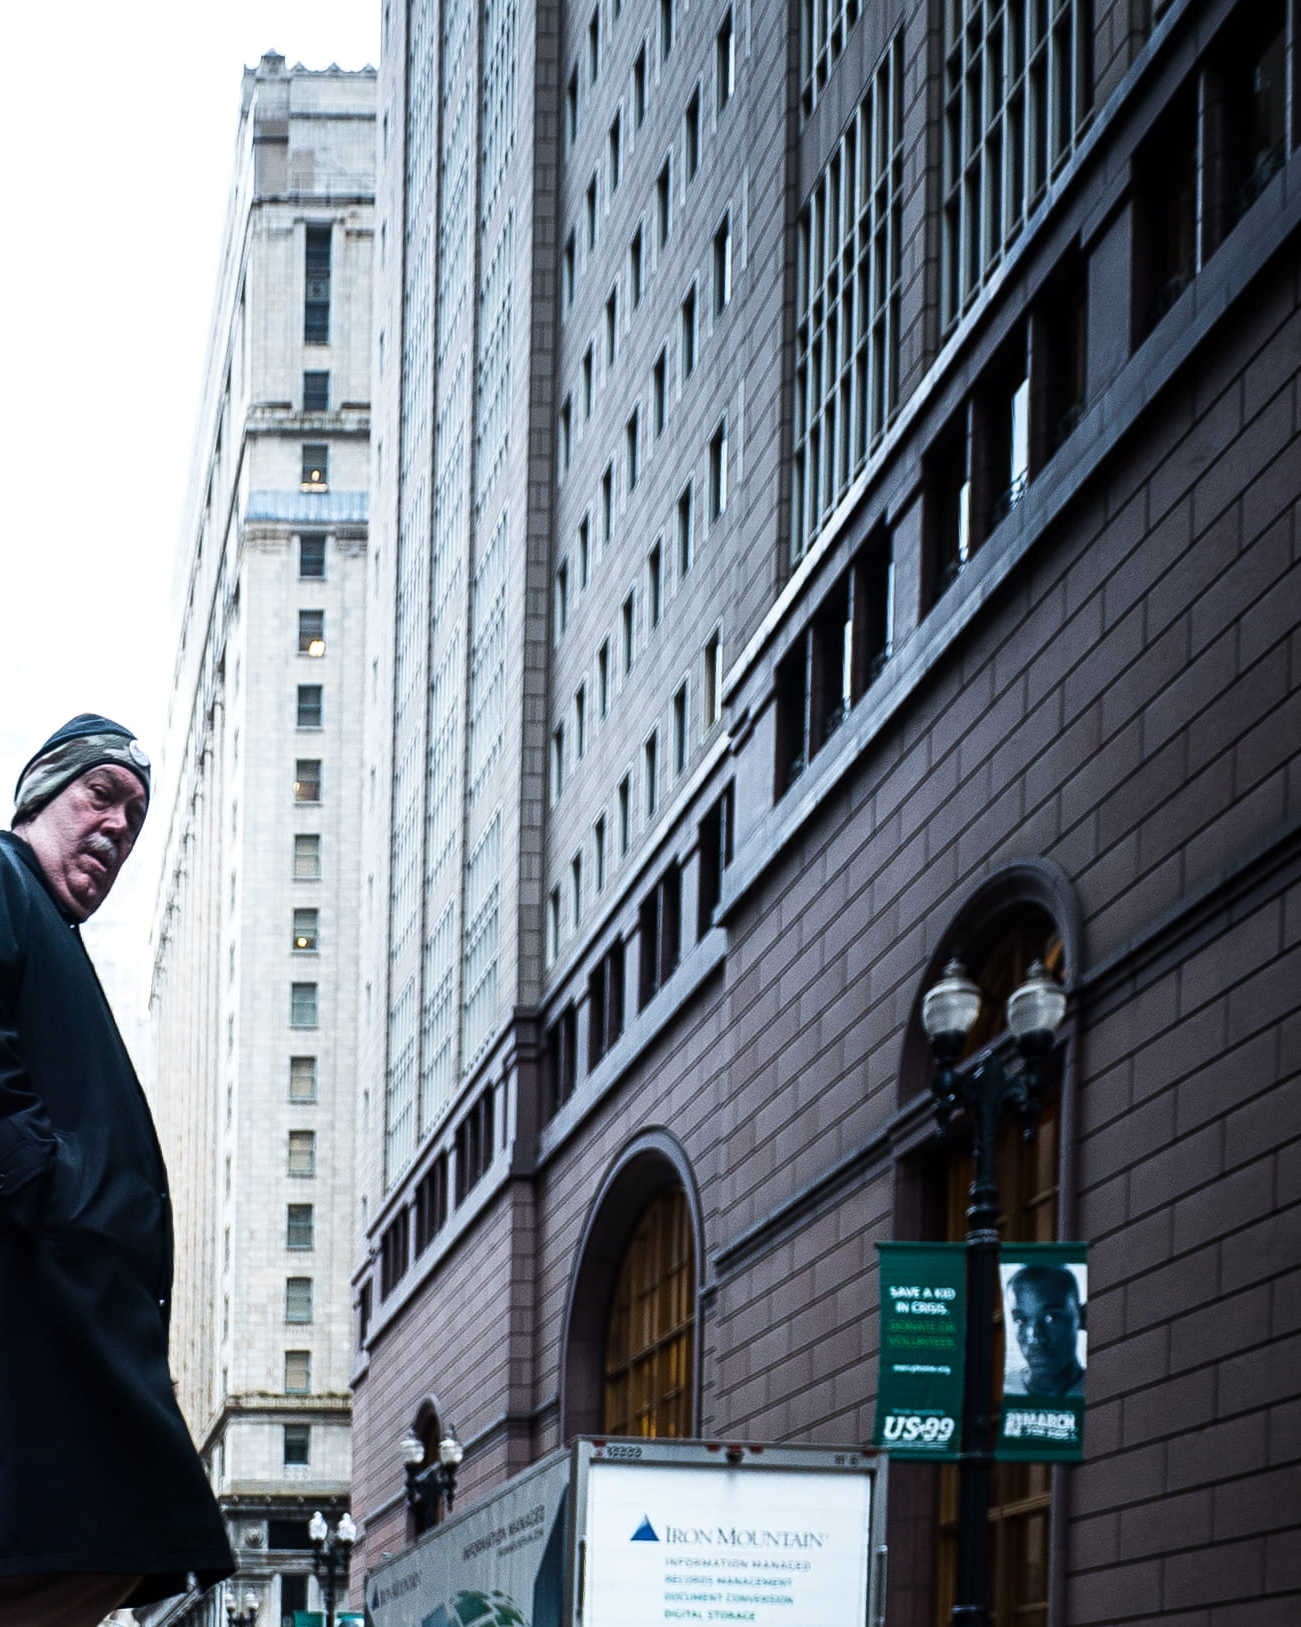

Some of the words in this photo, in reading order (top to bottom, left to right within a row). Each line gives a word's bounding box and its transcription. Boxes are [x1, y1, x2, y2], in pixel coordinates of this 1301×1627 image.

[889, 1286, 921, 1299] SAVE
[922, 1287, 933, 1299] A
[934, 1287, 956, 1300] KID
[895, 1301, 910, 1313] IN
[665, 1525, 713, 1545] IRON
[717, 1527, 824, 1548] MOUNTAIN
[665, 1557, 748, 1569] INFORMATION
[664, 1609, 702, 1620] DIGITAL
